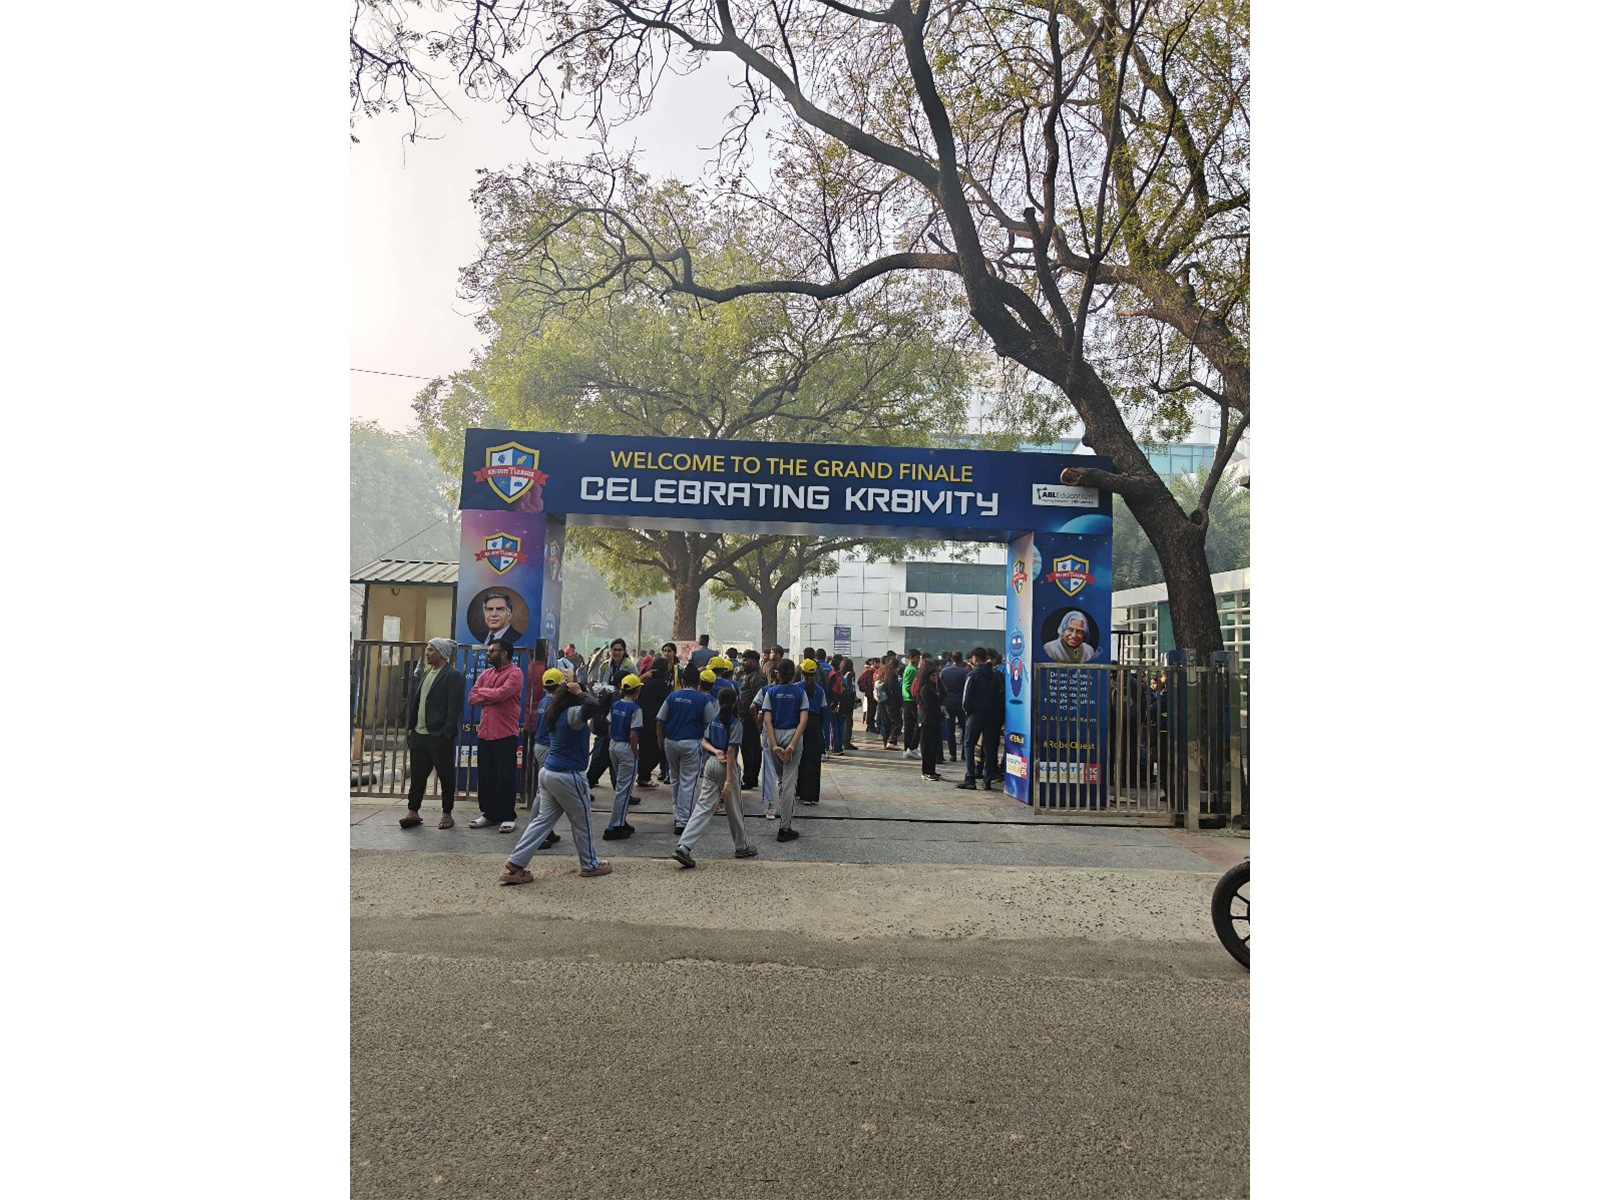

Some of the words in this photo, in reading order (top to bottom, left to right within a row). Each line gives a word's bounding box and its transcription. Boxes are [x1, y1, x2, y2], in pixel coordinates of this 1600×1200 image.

[610, 450, 726, 472] WELCOME
[730, 455, 761, 474] TO
[766, 457, 808, 476] THE
[814, 459, 893, 479] GRAND
[899, 463, 973, 483] FINALE
[580, 476, 830, 510] CELEBRATING
[845, 486, 999, 516] KR8IVITY
[907, 596, 918, 609] D
